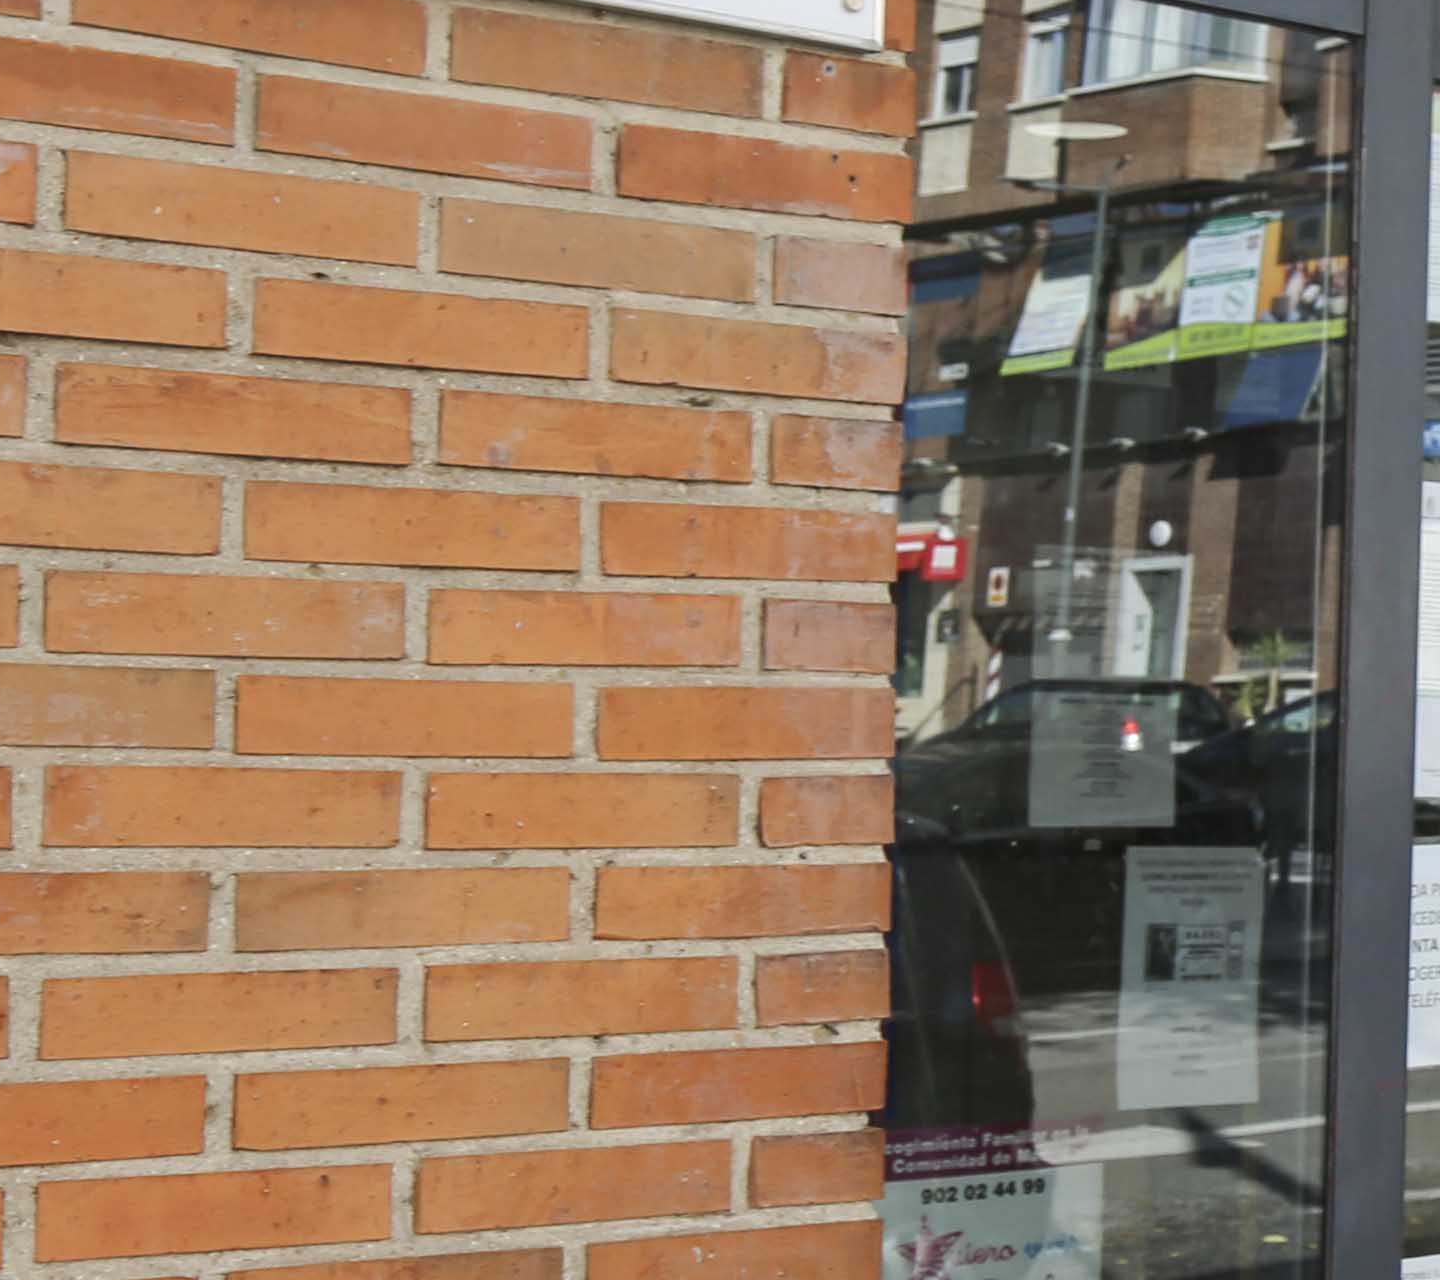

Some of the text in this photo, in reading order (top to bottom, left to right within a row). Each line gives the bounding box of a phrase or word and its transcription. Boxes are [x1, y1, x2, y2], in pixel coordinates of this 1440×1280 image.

[892, 1152, 987, 1173] Comunidad
[992, 1151, 1011, 1165] de
[921, 1178, 1046, 1205] 902 02 44 99
